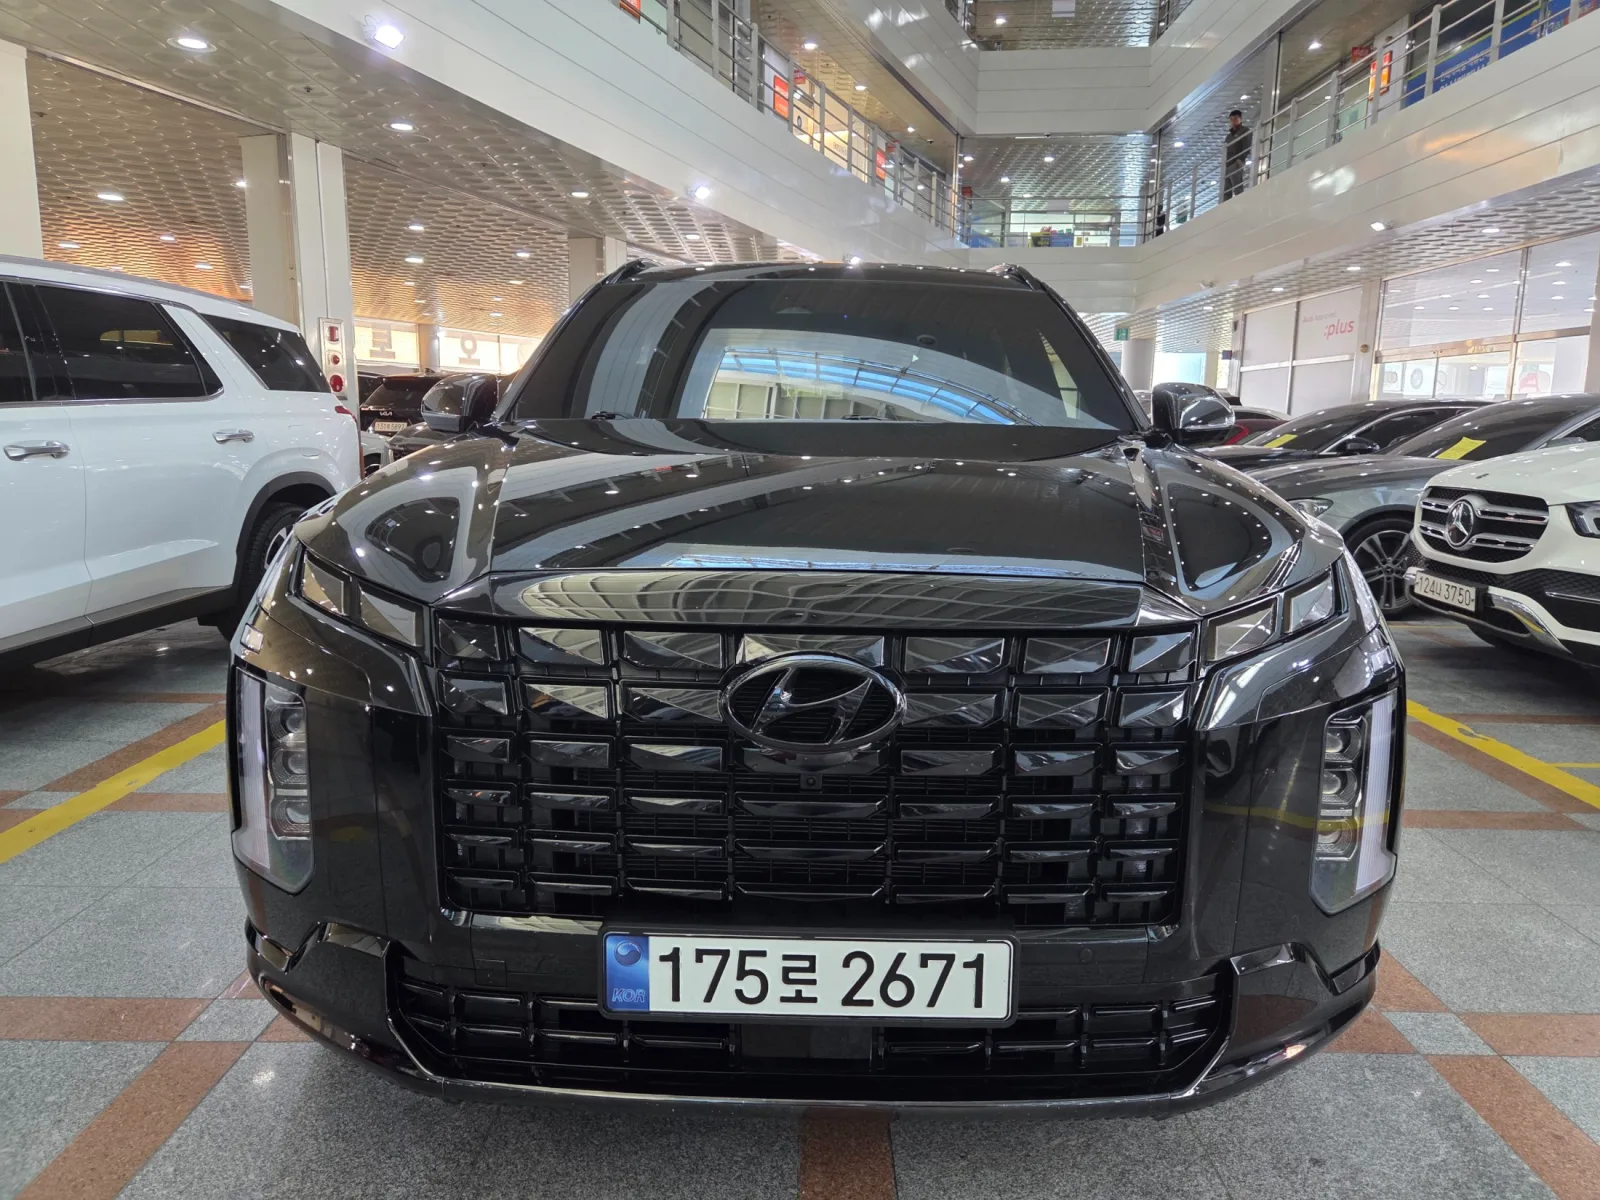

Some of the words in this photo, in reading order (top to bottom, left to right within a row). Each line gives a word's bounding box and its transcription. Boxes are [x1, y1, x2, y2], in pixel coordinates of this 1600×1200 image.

[1444, 583, 1471, 606] 3750
[658, 946, 818, 1006] 175로
[841, 950, 985, 1008] 2671
[612, 988, 646, 1003] KOR
